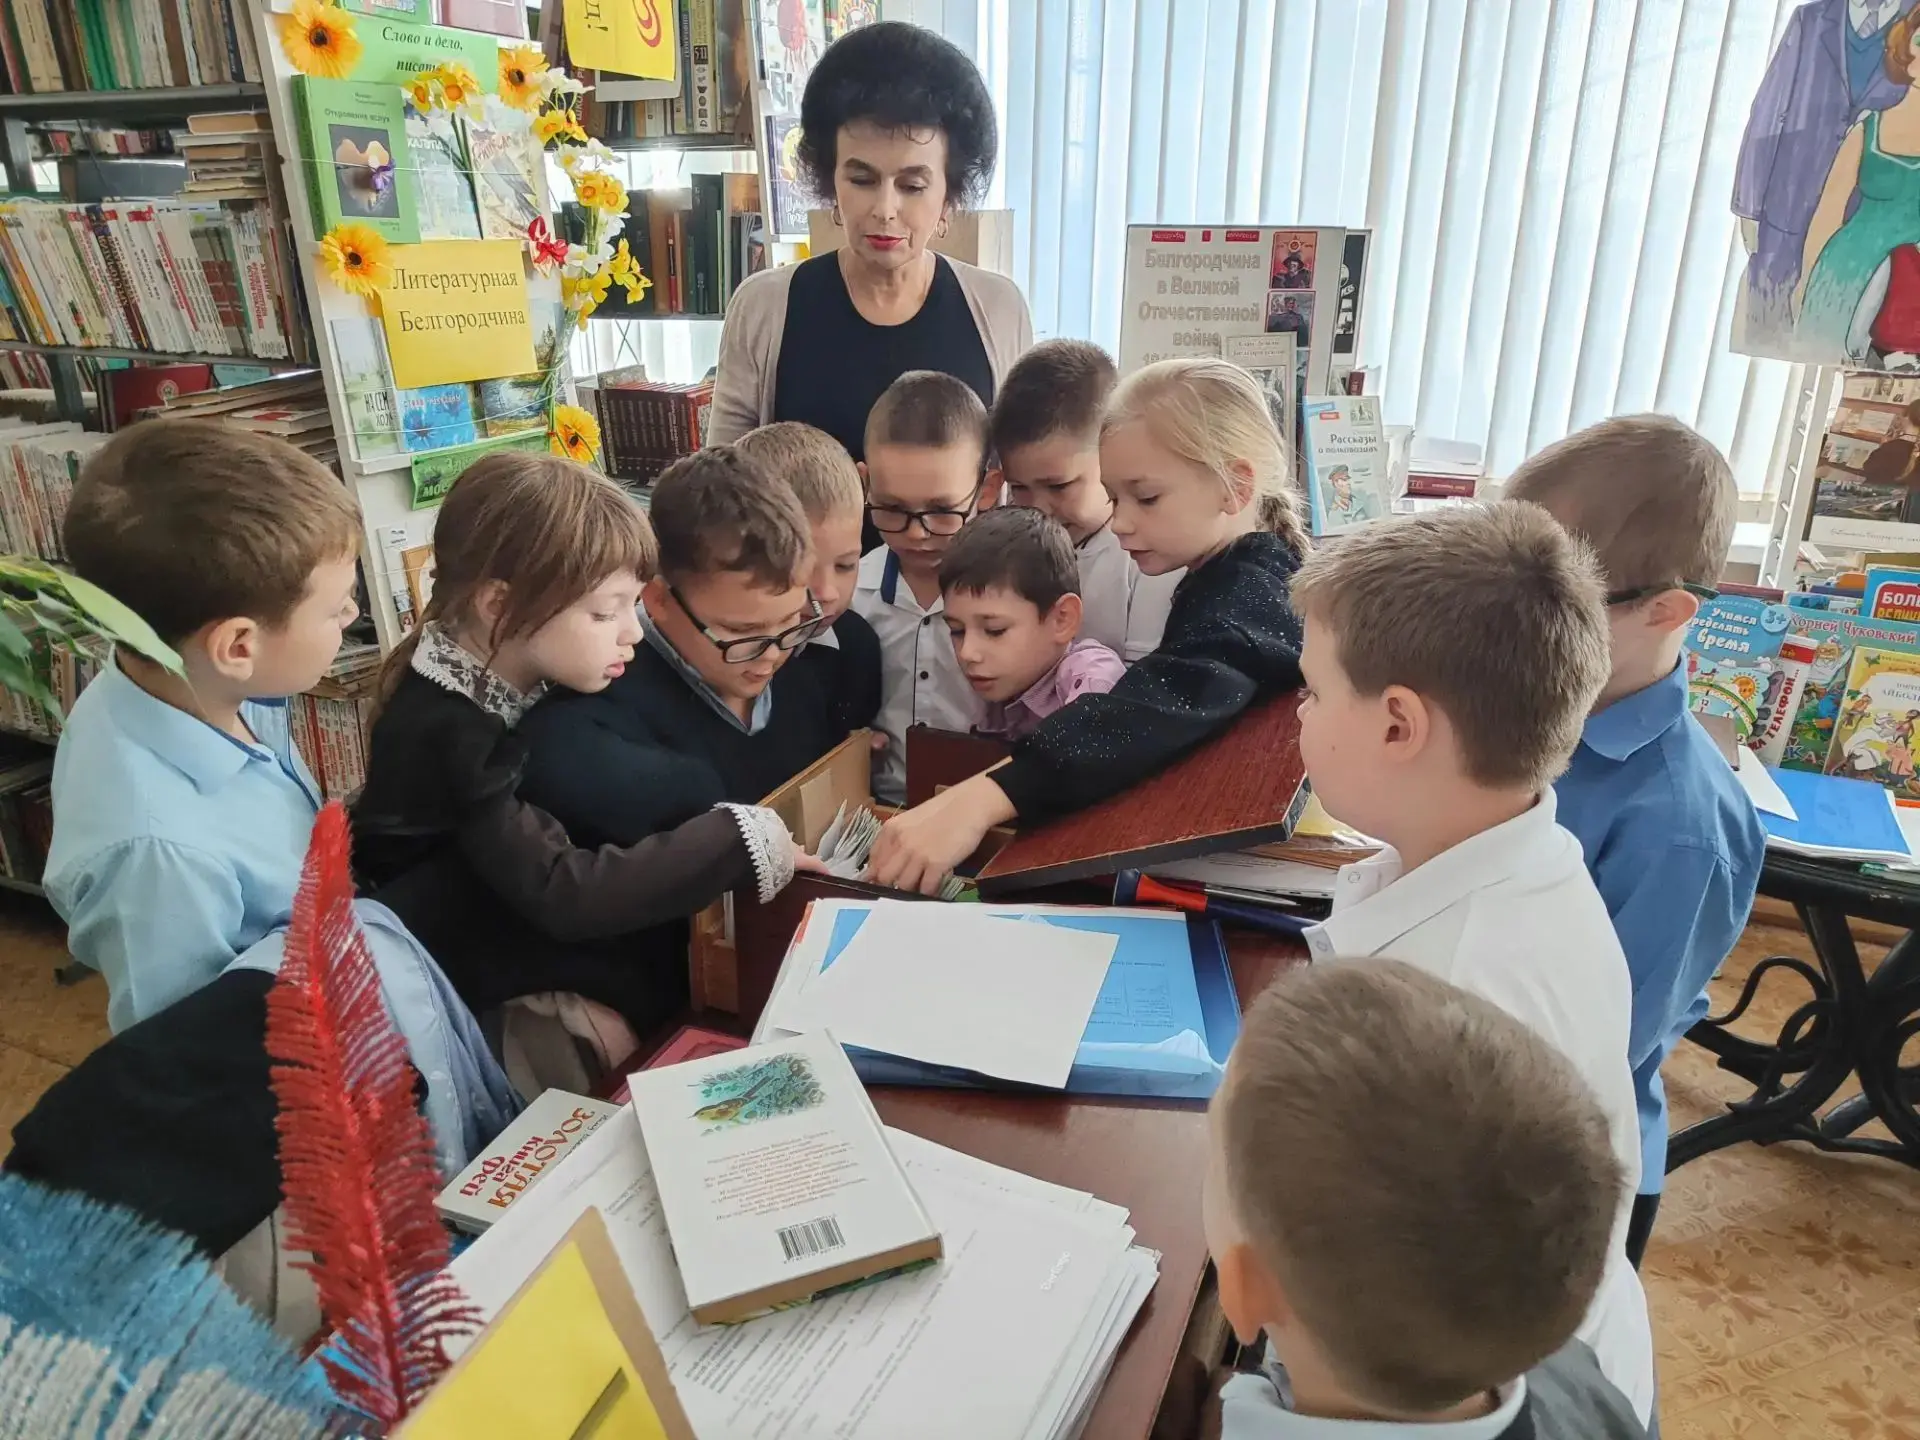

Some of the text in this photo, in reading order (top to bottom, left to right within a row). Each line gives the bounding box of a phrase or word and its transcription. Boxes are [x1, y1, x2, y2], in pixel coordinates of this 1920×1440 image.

[382, 26, 463, 51] Слово и дело,
[1145, 248, 1260, 273] Белгородчина
[392, 268, 518, 294] Литературная
[1171, 275, 1240, 296] Великой
[398, 309, 525, 334] Белгородчина
[1138, 301, 1260, 322] Отечественной
[1330, 434, 1378, 447] Рассказы
[1689, 616, 1749, 636] ределять
[1711, 607, 1757, 625] Учимся
[1765, 609, 1787, 624] 3+
[1697, 628, 1750, 653] время
[1791, 613, 1917, 645] Корней Чуковский
[487, 1107, 596, 1208] ЗОЛОТАЯ
